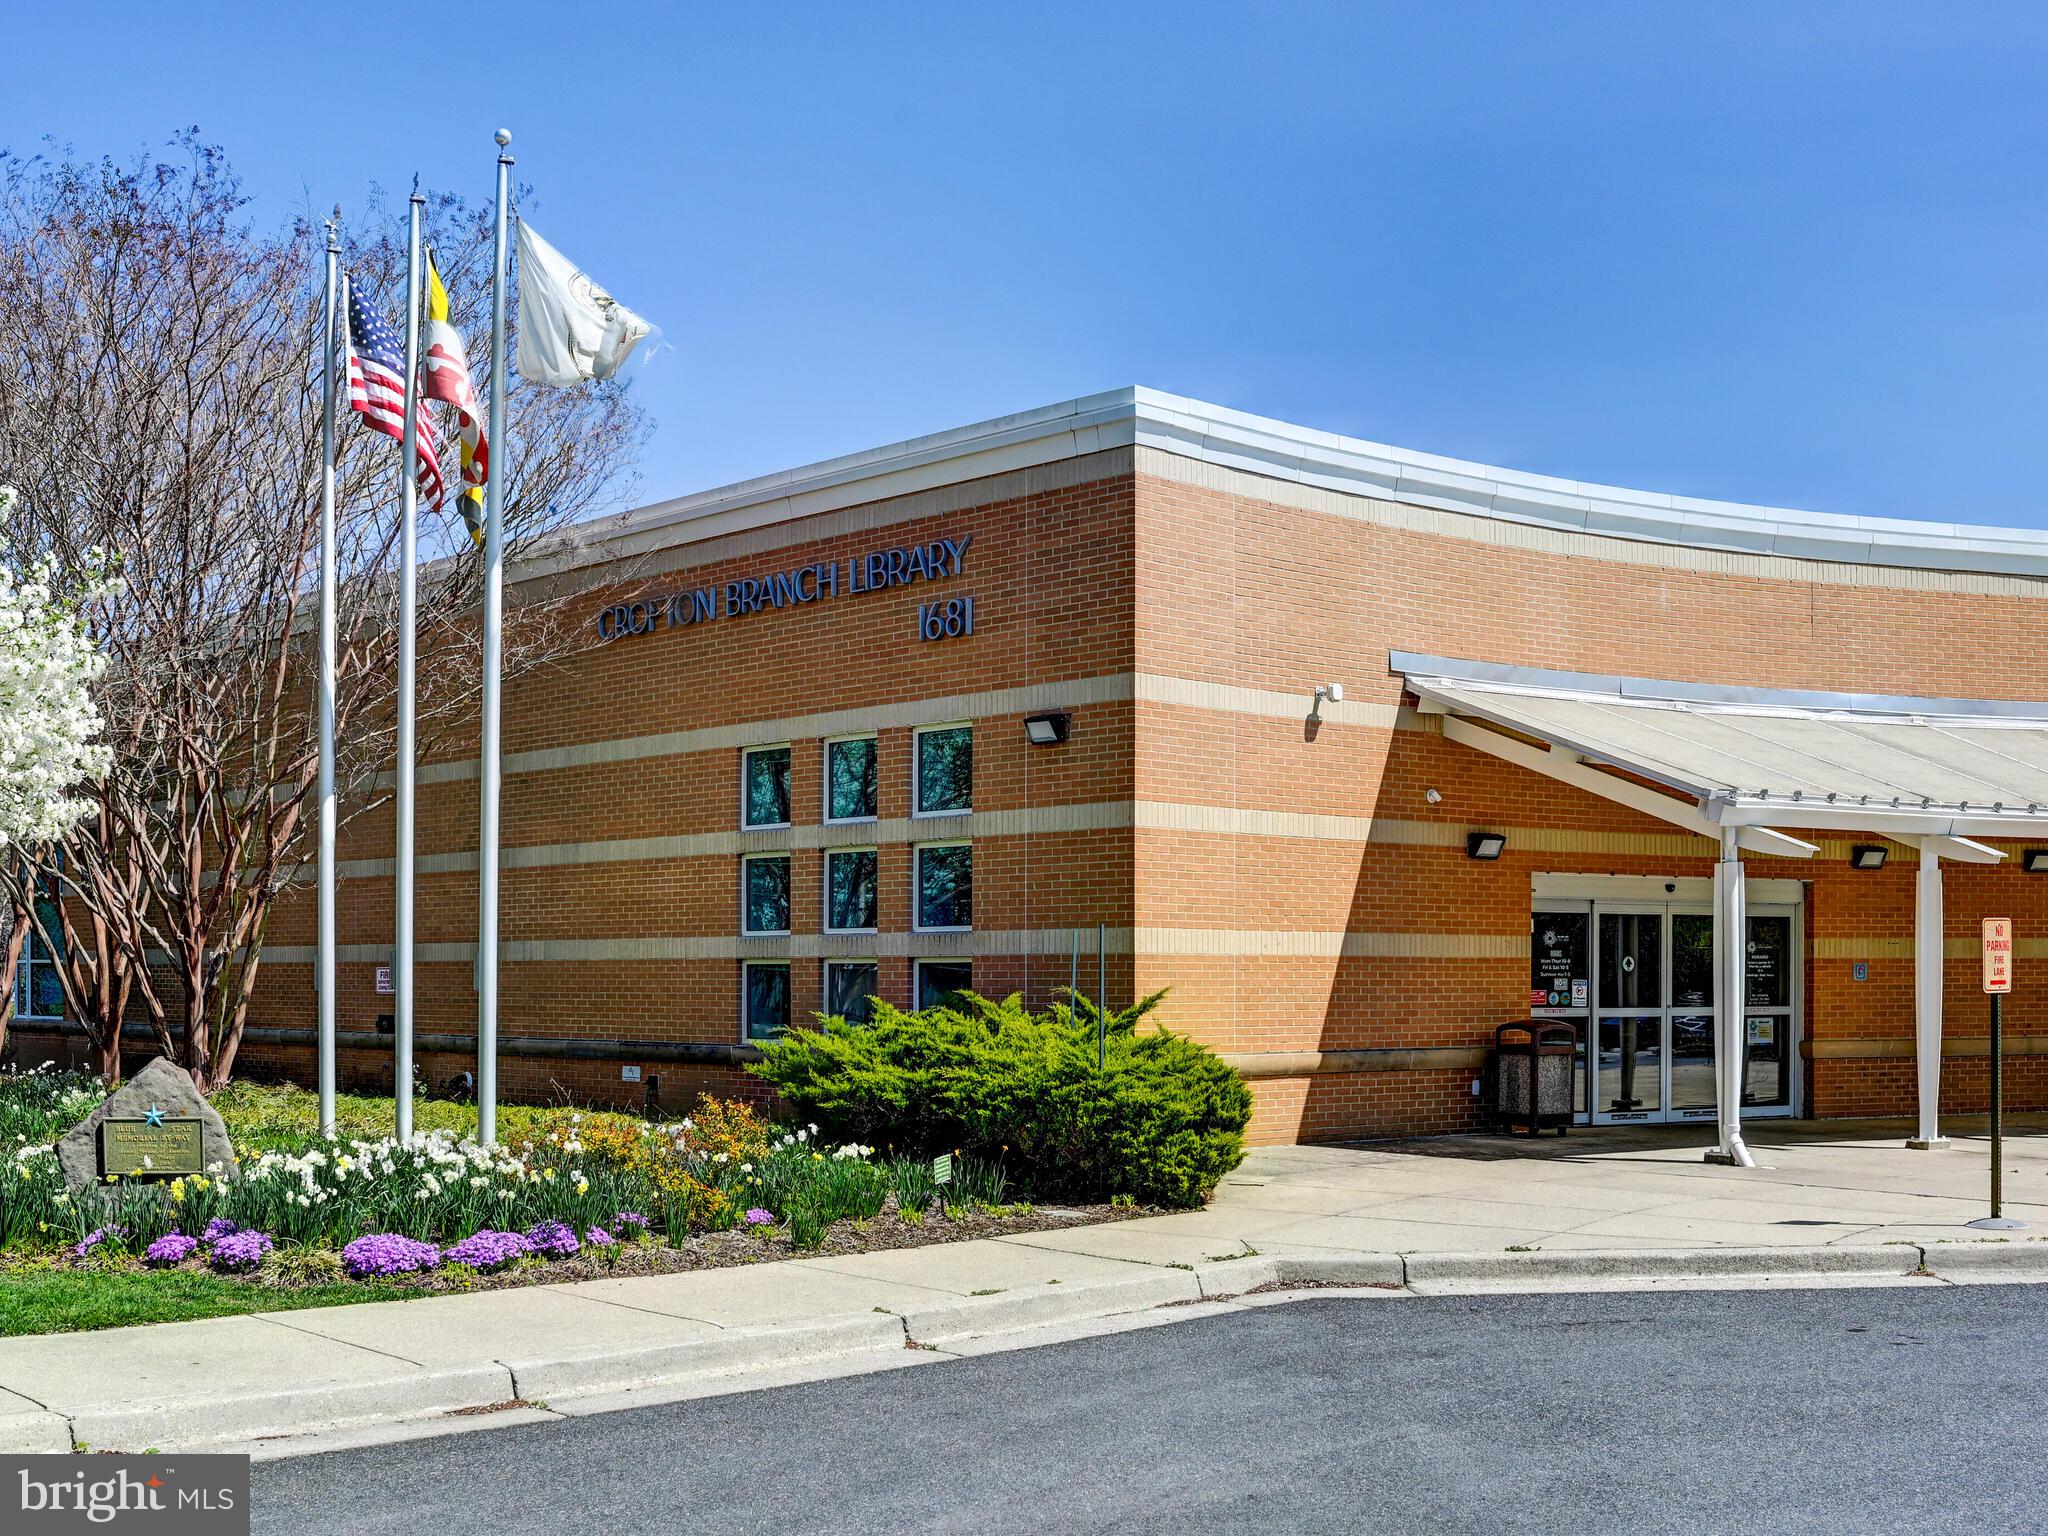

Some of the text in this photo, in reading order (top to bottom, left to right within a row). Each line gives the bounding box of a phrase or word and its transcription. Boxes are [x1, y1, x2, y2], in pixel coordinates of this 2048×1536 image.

[725, 562, 838, 617] BRANCH
[849, 533, 972, 593] LIBRARY
[919, 597, 973, 641] 1681
[1995, 924, 2003, 936] NO
[1986, 940, 2010, 951] PARKING
[1994, 955, 2004, 964] FIRE
[1993, 967, 2004, 976] LANE
[170, 1125, 192, 1133] STAR
[115, 1134, 157, 1142] MEMORIAL
